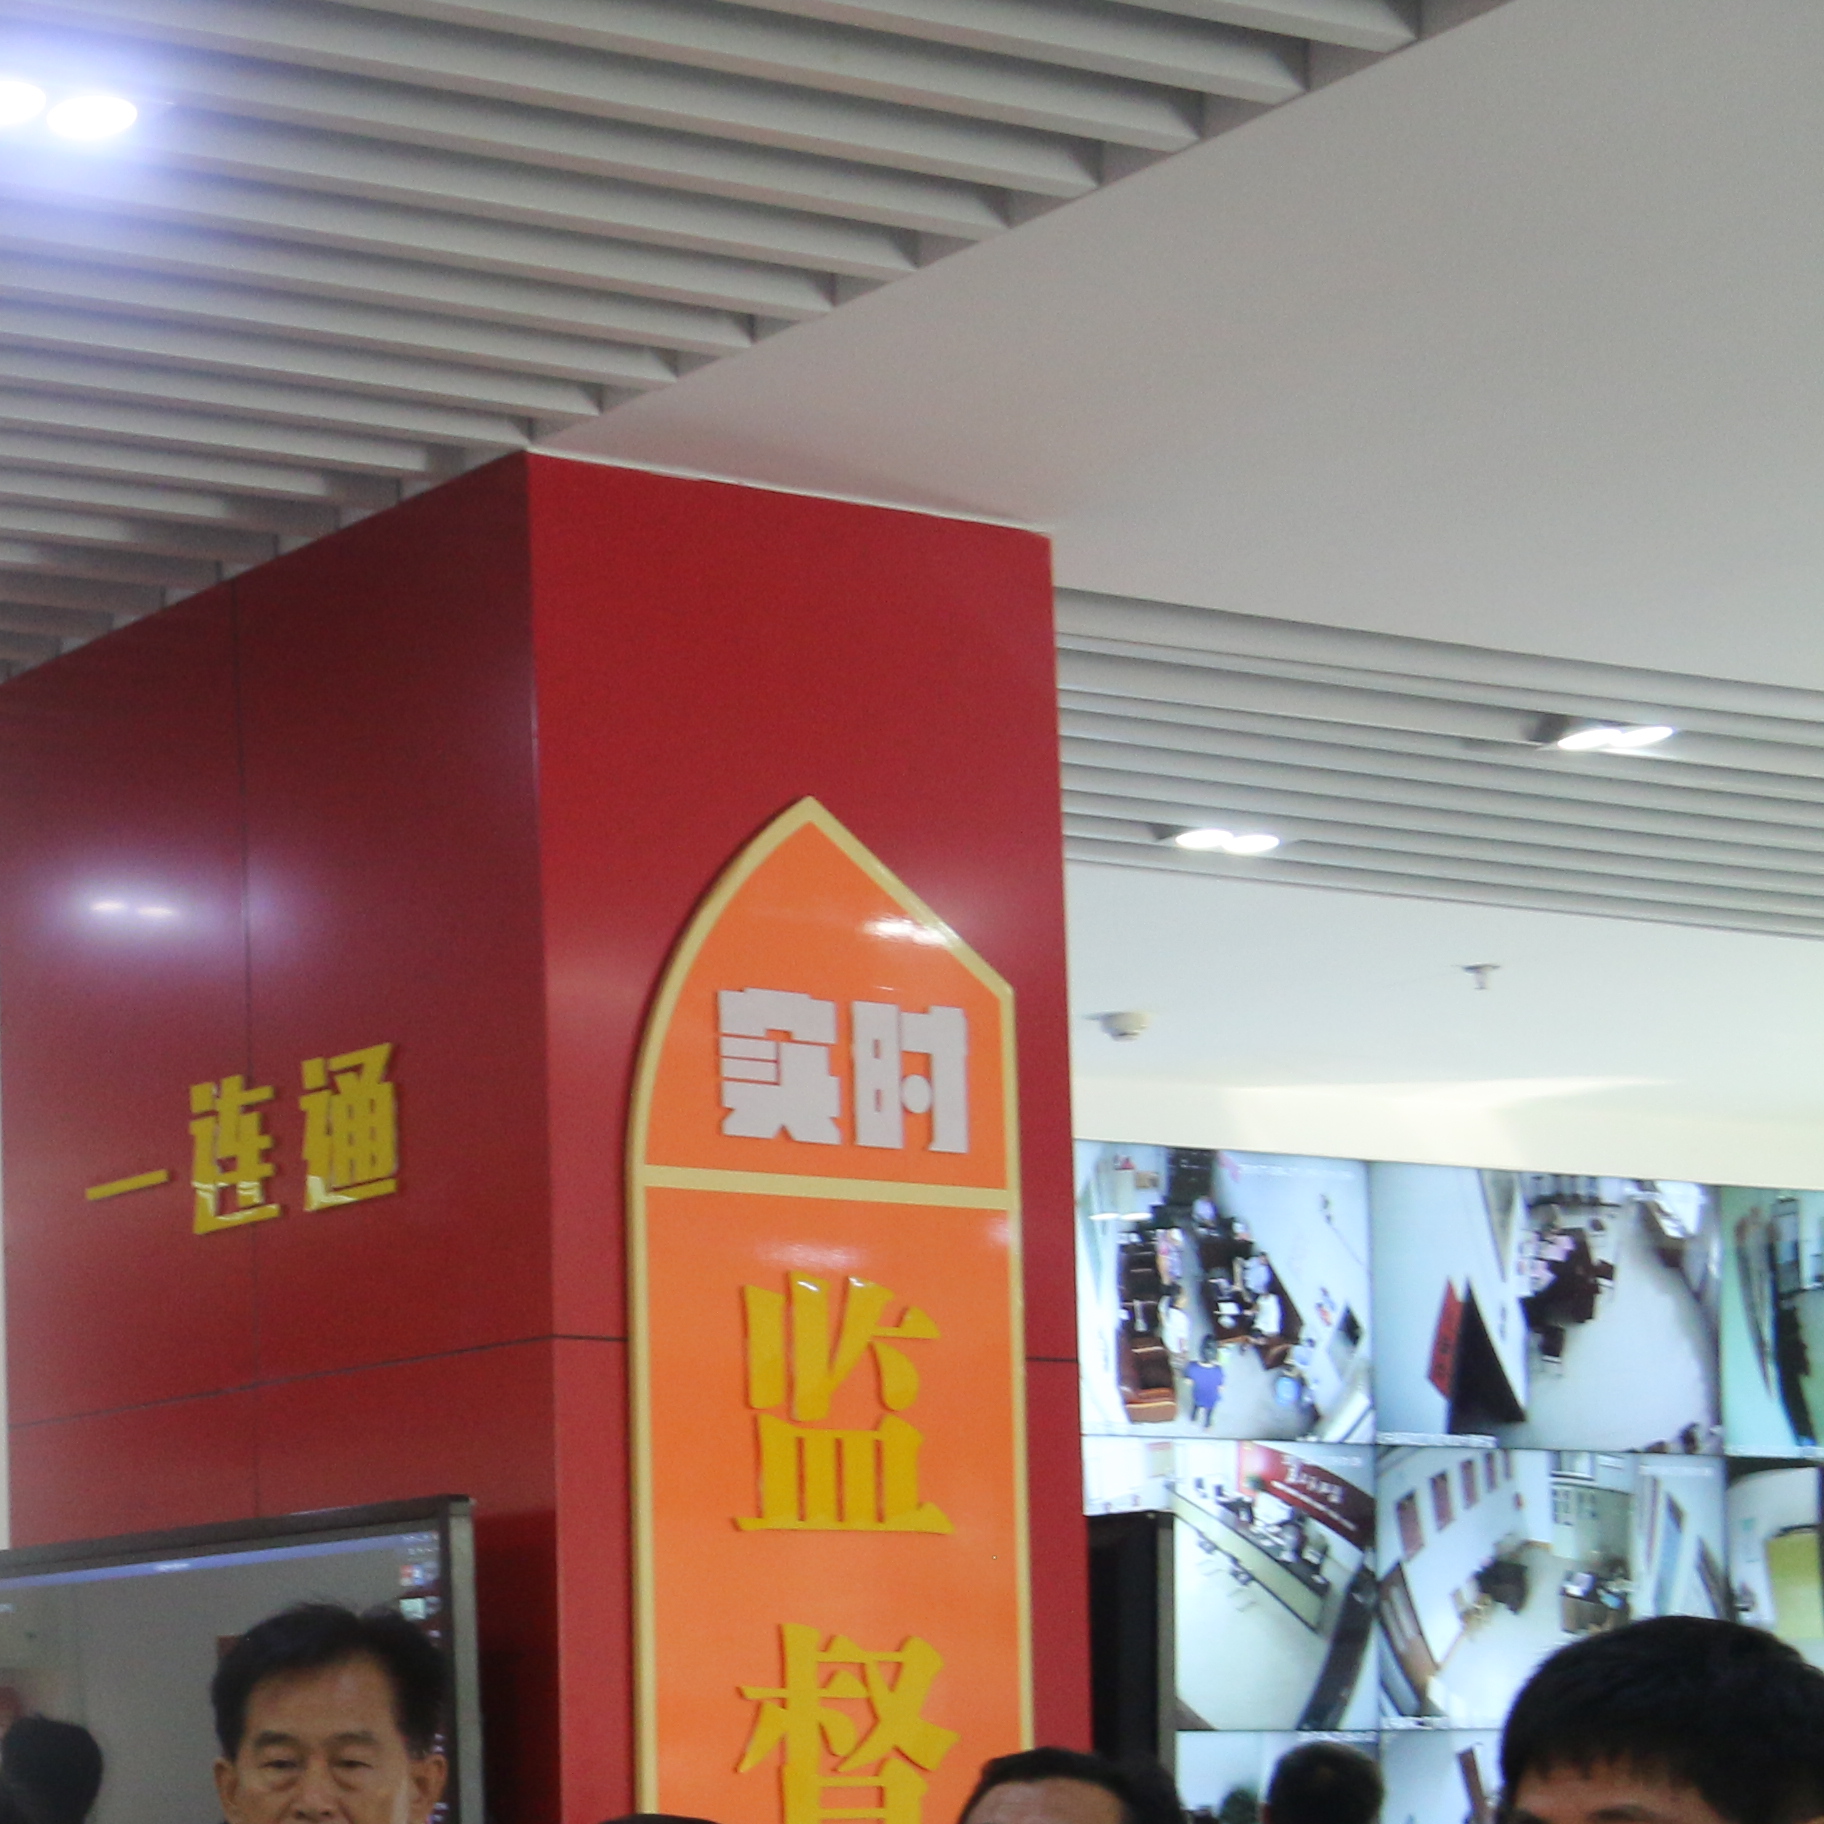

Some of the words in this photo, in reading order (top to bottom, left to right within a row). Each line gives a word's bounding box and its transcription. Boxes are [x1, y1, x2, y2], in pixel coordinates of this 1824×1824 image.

[85, 1042, 398, 1234] 一连通
[716, 987, 969, 1154] 实时
